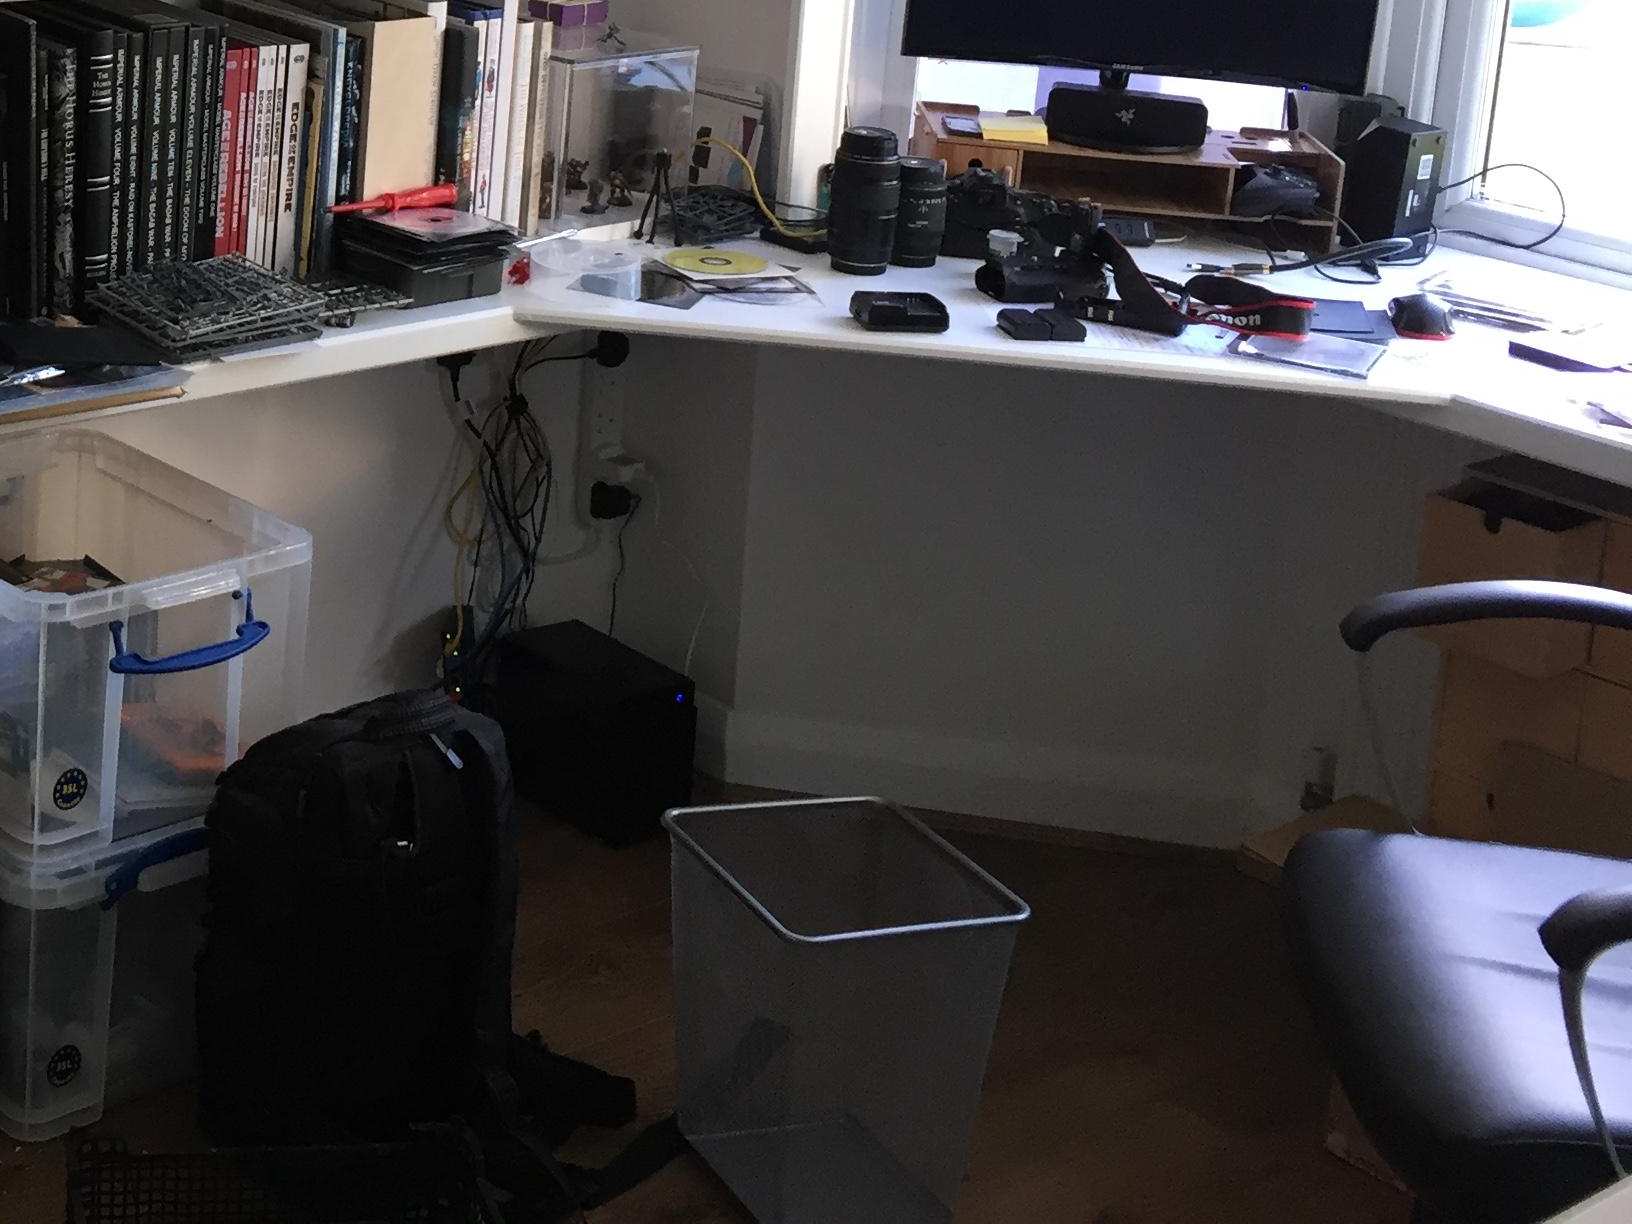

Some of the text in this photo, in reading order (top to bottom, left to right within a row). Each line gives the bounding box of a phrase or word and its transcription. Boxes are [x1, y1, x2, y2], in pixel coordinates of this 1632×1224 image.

[115, 48, 125, 85] IMPERIAL
[190, 39, 200, 76] IMPERIAL
[205, 44, 214, 79] IMPERIAL
[114, 86, 124, 122] ARMOUR
[188, 77, 199, 114] ARMOUR
[63, 65, 77, 208] THE HORUS HERESY
[186, 114, 196, 148] VOLUME
[203, 109, 211, 131] MODEL
[253, 90, 264, 158] EDGE EMPIRE
[262, 89, 273, 158] EDGE EMPIRE
[272, 88, 283, 156] EDGE EMPIRE
[112, 127, 122, 161] VOLUME
[147, 56, 163, 245] IMPERIAL ARMOUR VOLUME NINE THE BADAB WAR
[164, 54, 180, 242] IMPERIAL ARMOUR VOLUME TEN THE BADAB WAR
[200, 132, 209, 181] MASTERCLASS
[284, 102, 301, 213] EDGE EMPIRE
[112, 162, 121, 185] FOUR
[185, 150, 194, 181] ELEVEN
[215, 110, 233, 238] AGE REBELLION
[111, 190, 120, 207] THE
[183, 188, 192, 204] THE
[199, 182, 207, 207] VOLUME
[109, 207, 120, 253] ANPHELION
[182, 205, 191, 231] DOOM
